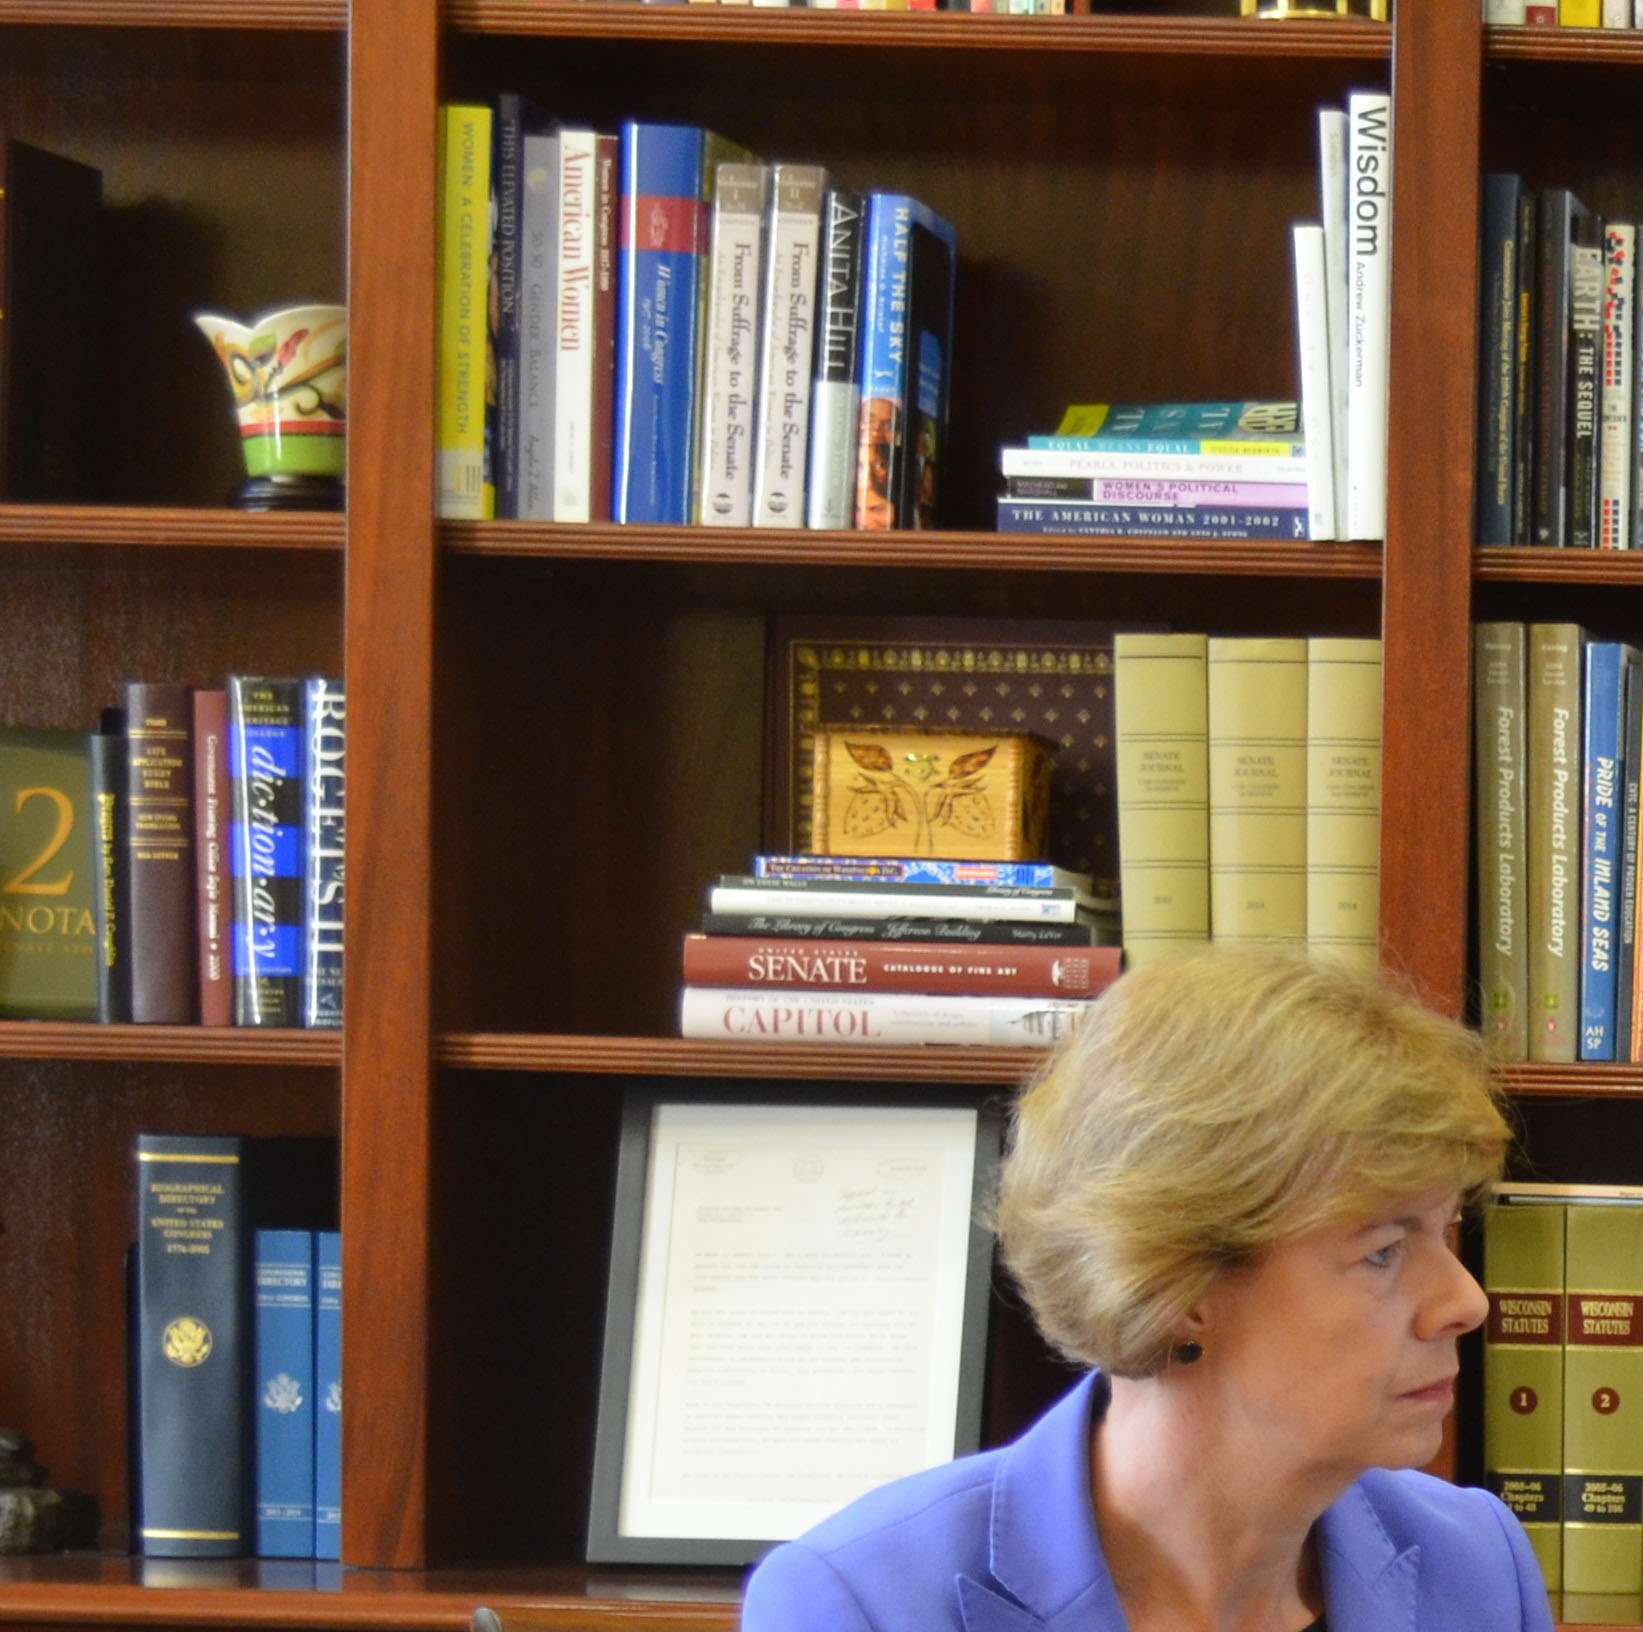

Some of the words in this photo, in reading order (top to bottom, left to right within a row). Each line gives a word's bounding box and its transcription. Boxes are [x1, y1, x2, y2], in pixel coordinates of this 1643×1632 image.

[1356, 106, 1389, 257] Wisdom
[562, 153, 593, 259] American
[895, 208, 909, 263] HALF
[732, 243, 751, 289] From
[789, 243, 809, 288] From
[891, 272, 906, 313] THE
[1355, 262, 1367, 310] Andrew
[1573, 248, 1602, 339] EARTH:
[560, 266, 592, 352] Women
[726, 295, 750, 366] Suffrage
[783, 293, 807, 365] Suffrage
[888, 322, 905, 363] SKY
[1353, 315, 1367, 389] Zuckerman
[1578, 347, 1595, 375] THE
[729, 371, 742, 388] to
[786, 370, 799, 387] to
[728, 393, 748, 420] the
[784, 392, 804, 419] the
[1576, 381, 1594, 439] SEQUEL
[725, 424, 745, 481] Senate
[780, 424, 800, 480] Senate
[1103, 491, 1179, 501] DISCOURSE
[1169, 483, 1239, 494] POLITICAL
[1012, 510, 1042, 521] THE
[1051, 511, 1131, 523] AMERICAN
[1138, 512, 1195, 525] WOMAN
[1202, 514, 1281, 527] 2001-2002
[1498, 706, 1516, 764] Forest
[1552, 706, 1570, 765] Forest
[207, 734, 219, 795] Government
[1139, 764, 1185, 774] JOURNAL
[1143, 752, 1182, 762] SENATE
[1235, 756, 1276, 767] SENATE
[1330, 756, 1371, 767] SENATE
[1232, 768, 1280, 778] JOURNAL
[1328, 768, 1374, 778] JOURNAL
[1595, 757, 1615, 809] PRIDE
[205, 798, 219, 839] Printing
[1497, 766, 1515, 849] Products
[1551, 768, 1570, 850] Products
[1594, 812, 1607, 829] OF
[3, 786, 75, 896] 2
[1594, 831, 1607, 853] THE
[207, 842, 220, 873] Office
[206, 875, 219, 900] Style
[1592, 856, 1612, 923] INLAND
[1495, 853, 1517, 957] Laboratory
[1547, 853, 1569, 959] Laboratory
[207, 903, 219, 939] Manual
[757, 947, 805, 955] UNITED
[812, 949, 860, 957] STATES
[1591, 925, 1610, 972] SEAS
[208, 954, 220, 981] 2000
[746, 954, 869, 985] SENATE
[882, 963, 944, 975] CATALOGUE
[949, 965, 963, 976] OF
[967, 966, 993, 977] FINE
[997, 967, 1019, 979] ART
[723, 1006, 881, 1038] CAPITOL
[150, 1183, 224, 1194] BIOGRAPHICAL
[159, 1194, 216, 1205] DIRECTORY
[151, 1218, 188, 1229] UNITED
[189, 1219, 224, 1229] STATES
[162, 1229, 213, 1239] CONGRESS
[1500, 1299, 1552, 1317] WISCONSIN
[1580, 1300, 1634, 1318] WISCONSIN
[1502, 1317, 1550, 1335] STATUTES
[1582, 1318, 1631, 1336] STATUTES
[1520, 1393, 1528, 1407] 1
[1600, 1394, 1611, 1408] 2
